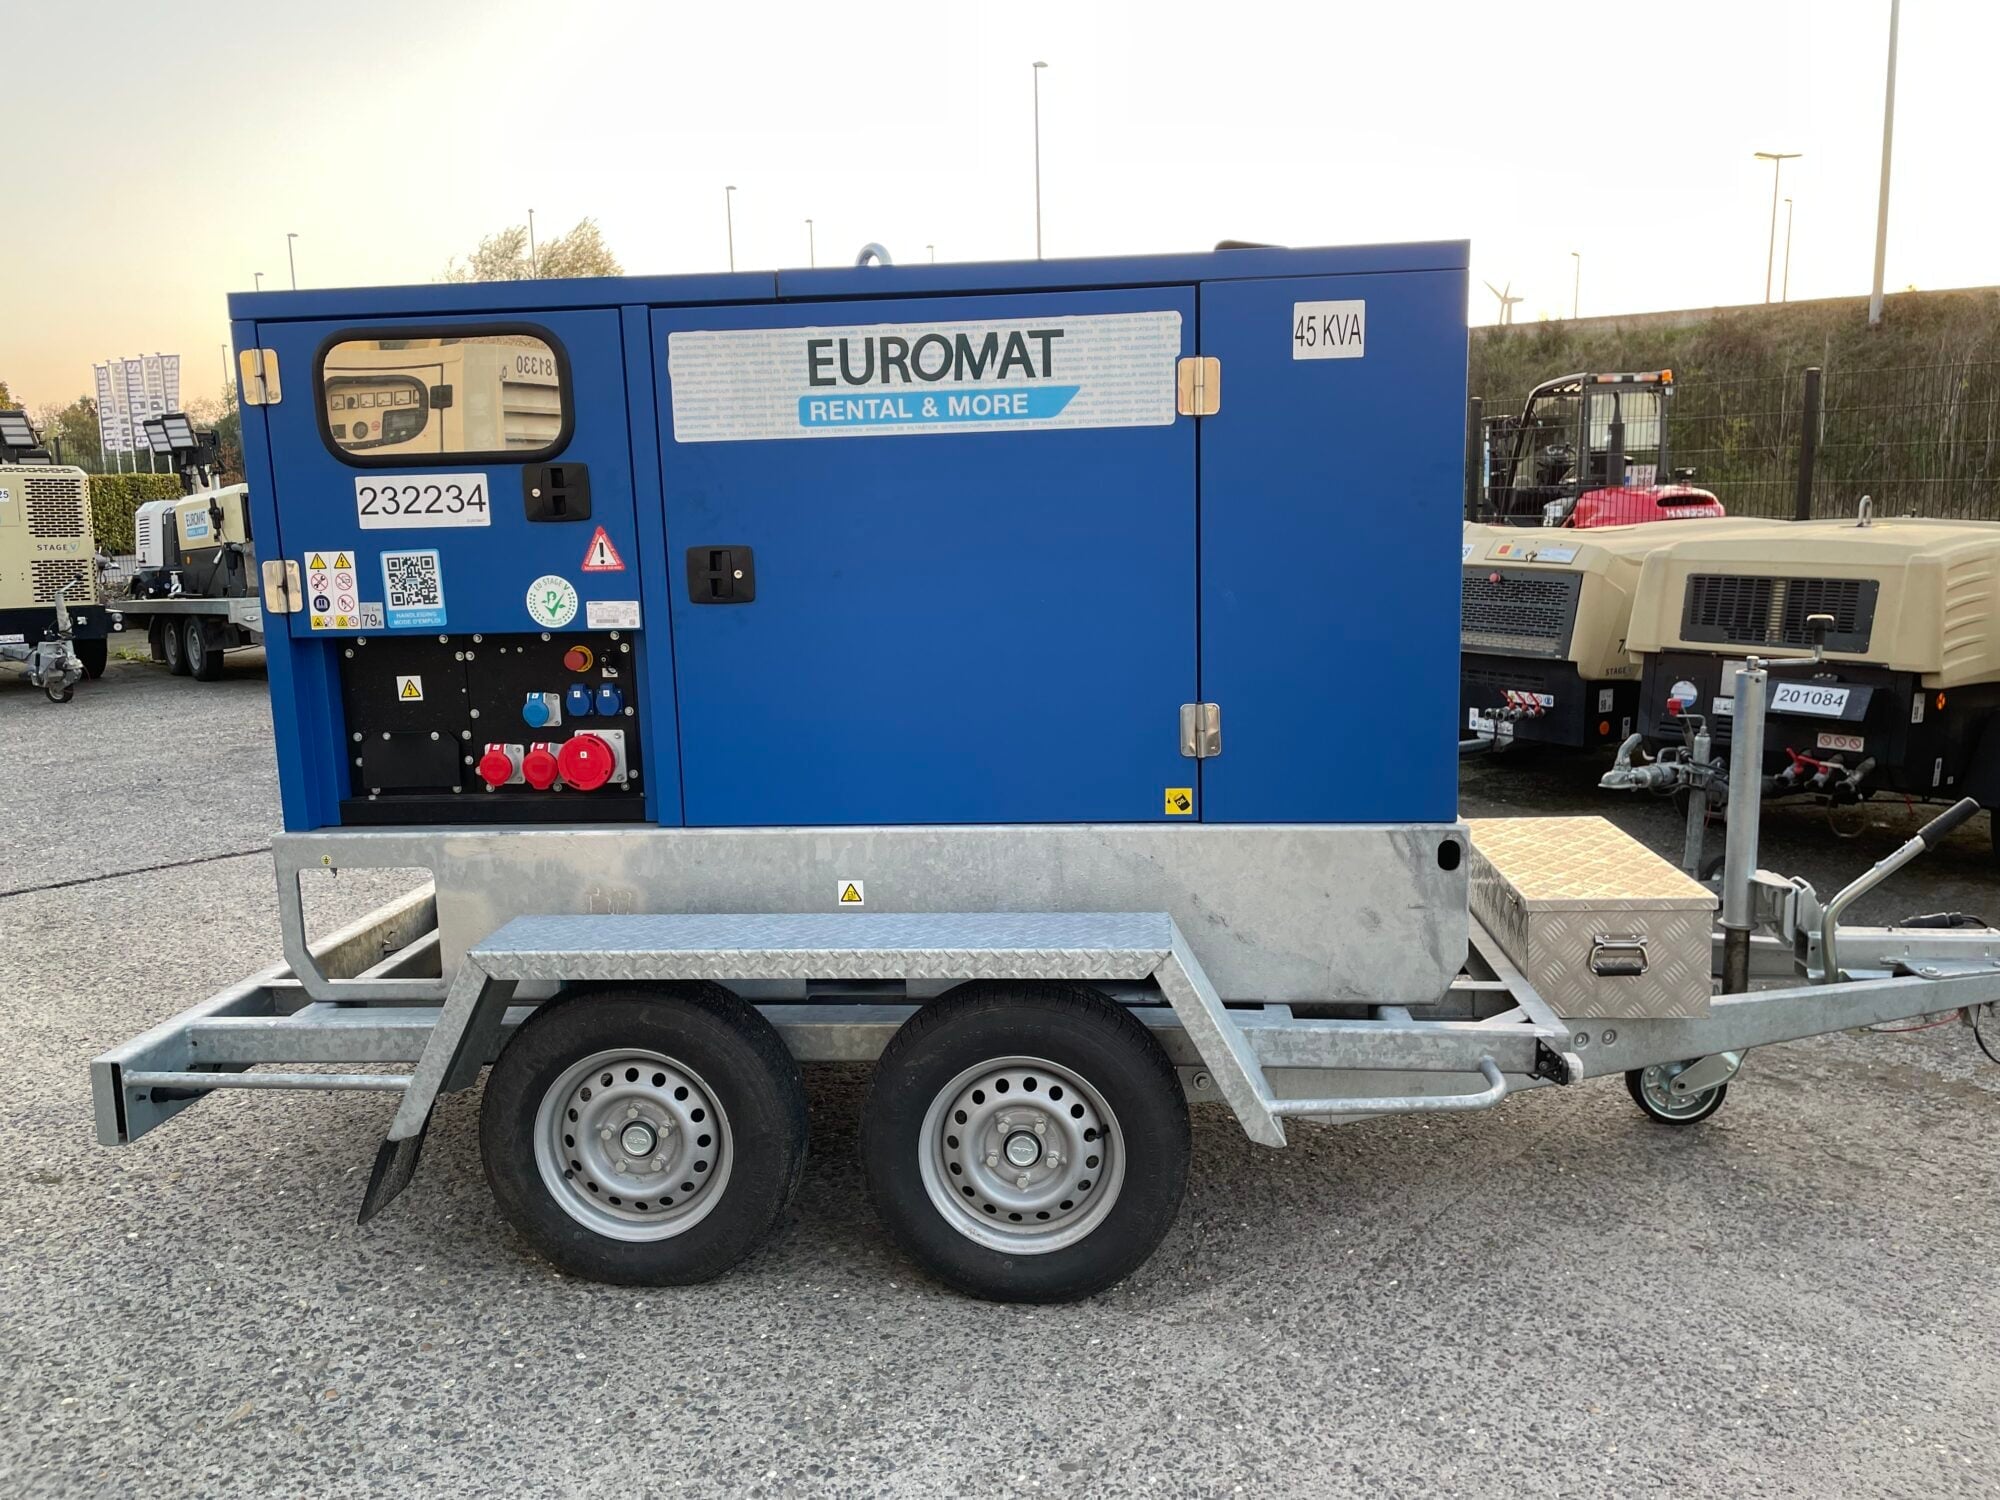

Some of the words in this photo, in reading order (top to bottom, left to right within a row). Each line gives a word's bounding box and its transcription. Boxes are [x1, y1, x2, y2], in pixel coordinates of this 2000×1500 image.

[1295, 315, 1316, 347] 45
[1323, 313, 1362, 346] KVA
[807, 328, 1065, 387] EUROMAT
[809, 397, 913, 422] RENTAL
[921, 396, 940, 418] &
[948, 392, 1029, 417] MORE
[359, 484, 486, 515] 232234
[362, 613, 378, 627] 79
[1779, 688, 1844, 708] 201084
